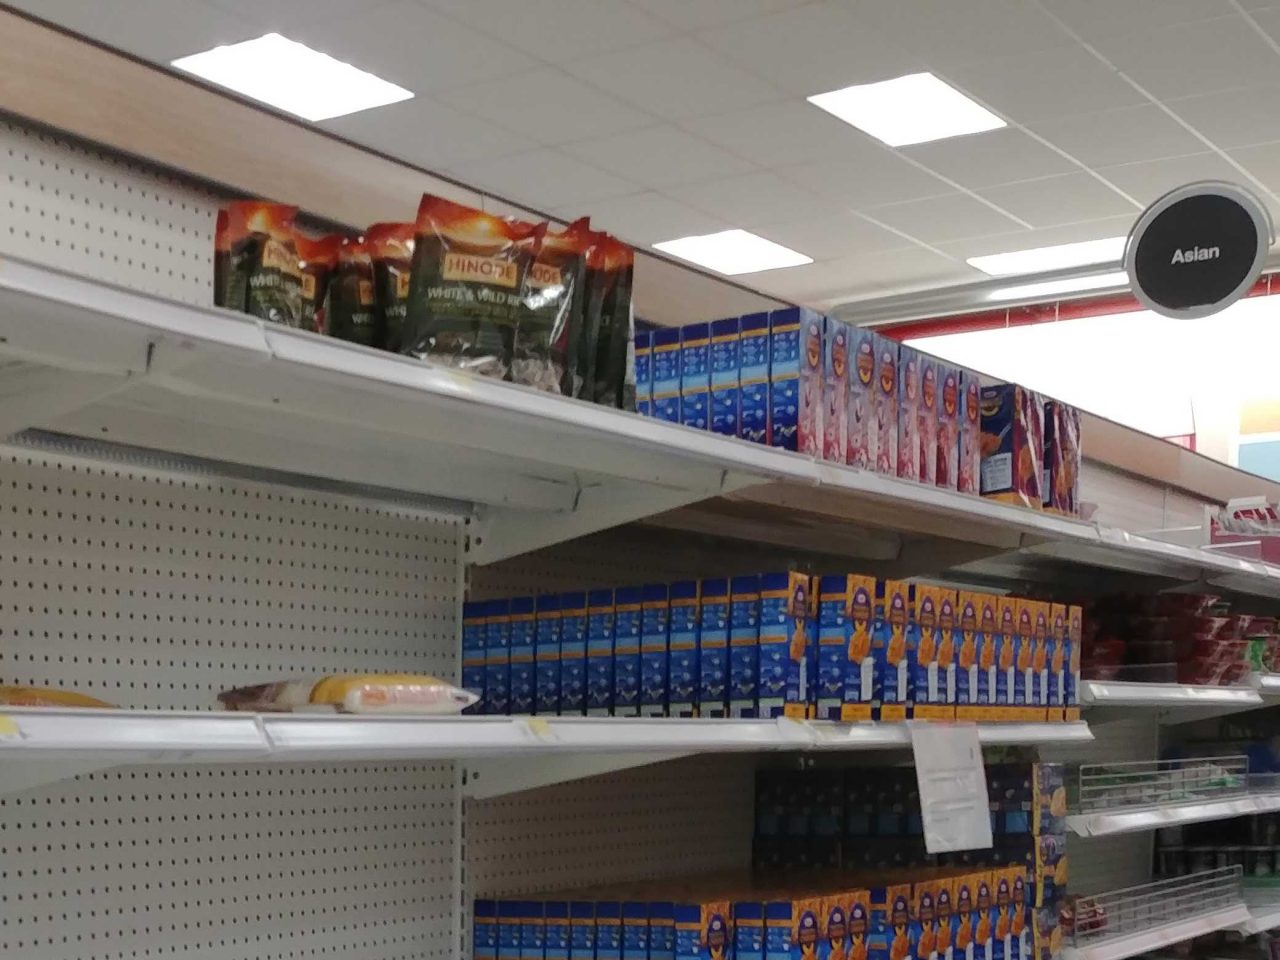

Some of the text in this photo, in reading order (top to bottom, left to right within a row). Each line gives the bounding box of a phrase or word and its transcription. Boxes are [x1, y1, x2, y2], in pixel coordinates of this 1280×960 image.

[1170, 245, 1221, 266] Asian
[447, 257, 515, 281] HINODE
[477, 288, 506, 304] WILD
